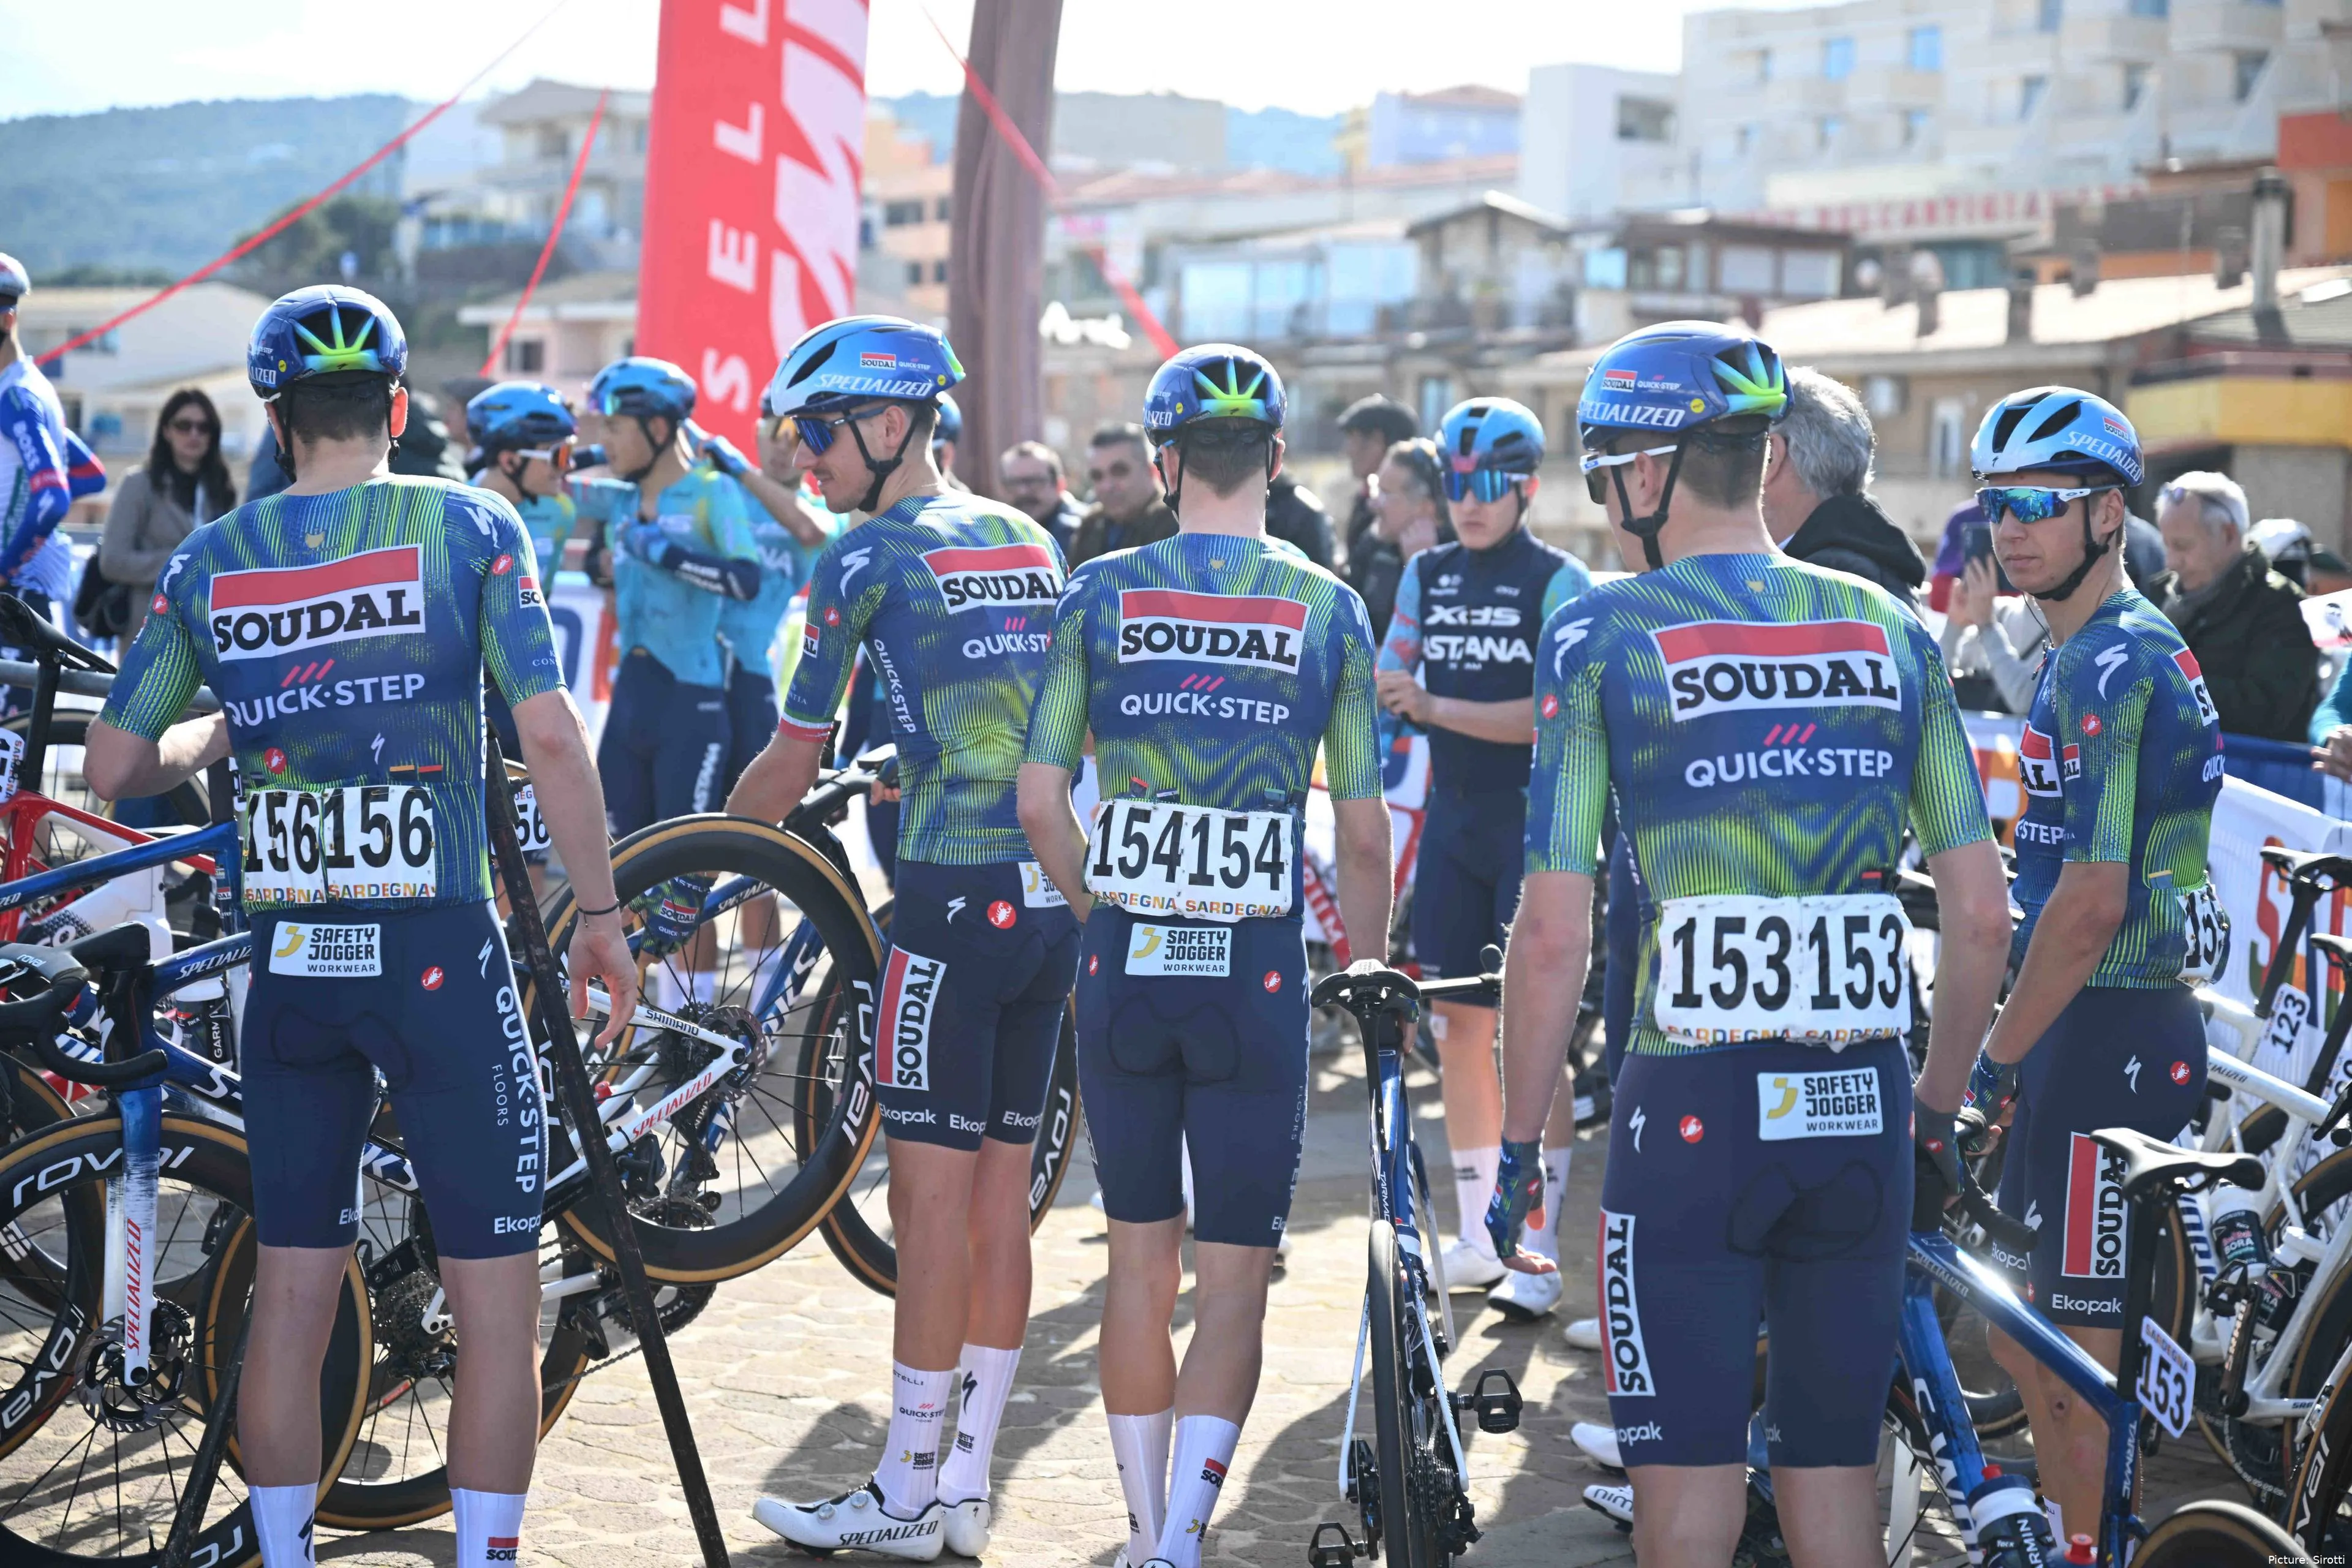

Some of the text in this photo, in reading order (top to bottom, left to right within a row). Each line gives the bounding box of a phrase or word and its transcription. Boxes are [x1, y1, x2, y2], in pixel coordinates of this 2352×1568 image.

[861, 358, 895, 369] SOUDAL
[815, 374, 933, 397] SPECIALIZED
[1603, 379, 1634, 392] SOUDAL
[1580, 401, 1685, 427] SPECIALIZED
[2105, 423, 2130, 442] SOUDAL
[2062, 431, 2141, 482] SPECIALIZED
[213, 589, 421, 653] SOUDAL
[1121, 622, 1297, 667] SOUDAL
[1672, 660, 1898, 711] SOUDAL
[245, 786, 432, 875] 156 156
[1093, 805, 1285, 891] 154 154
[328, 882, 429, 901] SARDEGNA
[1186, 900, 1281, 916] SARDEGNA
[311, 928, 375, 944] SAFETY
[1167, 930, 1227, 944] SAFETY
[17, 954, 47, 968] roval
[308, 944, 375, 961] JOGGER
[1165, 946, 1225, 961] JOGGER
[1672, 914, 1904, 1011] 153 153
[307, 963, 376, 973] WORKWEAR
[1164, 963, 1225, 973] WORKWEAR
[645, 1009, 699, 1036] SHIMANO
[897, 962, 941, 1088] SOUDAL
[2271, 993, 2307, 1054] 123
[841, 980, 874, 1147] roval
[491, 1065, 509, 1126] FLOORS
[1804, 1074, 1874, 1096] SAFETY
[633, 1072, 712, 1137] SPECIALIZED
[1291, 1085, 1303, 1140] FLOORS
[1806, 1095, 1877, 1117] JOGGER
[1806, 1120, 1878, 1131] WORKWEAR
[126, 1218, 141, 1356] SPECIALIZED
[1913, 1252, 1970, 1297] SPECIALIZED
[1608, 1219, 1647, 1392] SOUDAL
[2052, 1294, 2122, 1316] Ekopak
[2146, 1323, 2189, 1374] SARDEGNA
[2143, 1344, 2187, 1430] 153
[2122, 1419, 2138, 1500] TARMAC
[835, 1520, 939, 1547] SPECIALIZED
